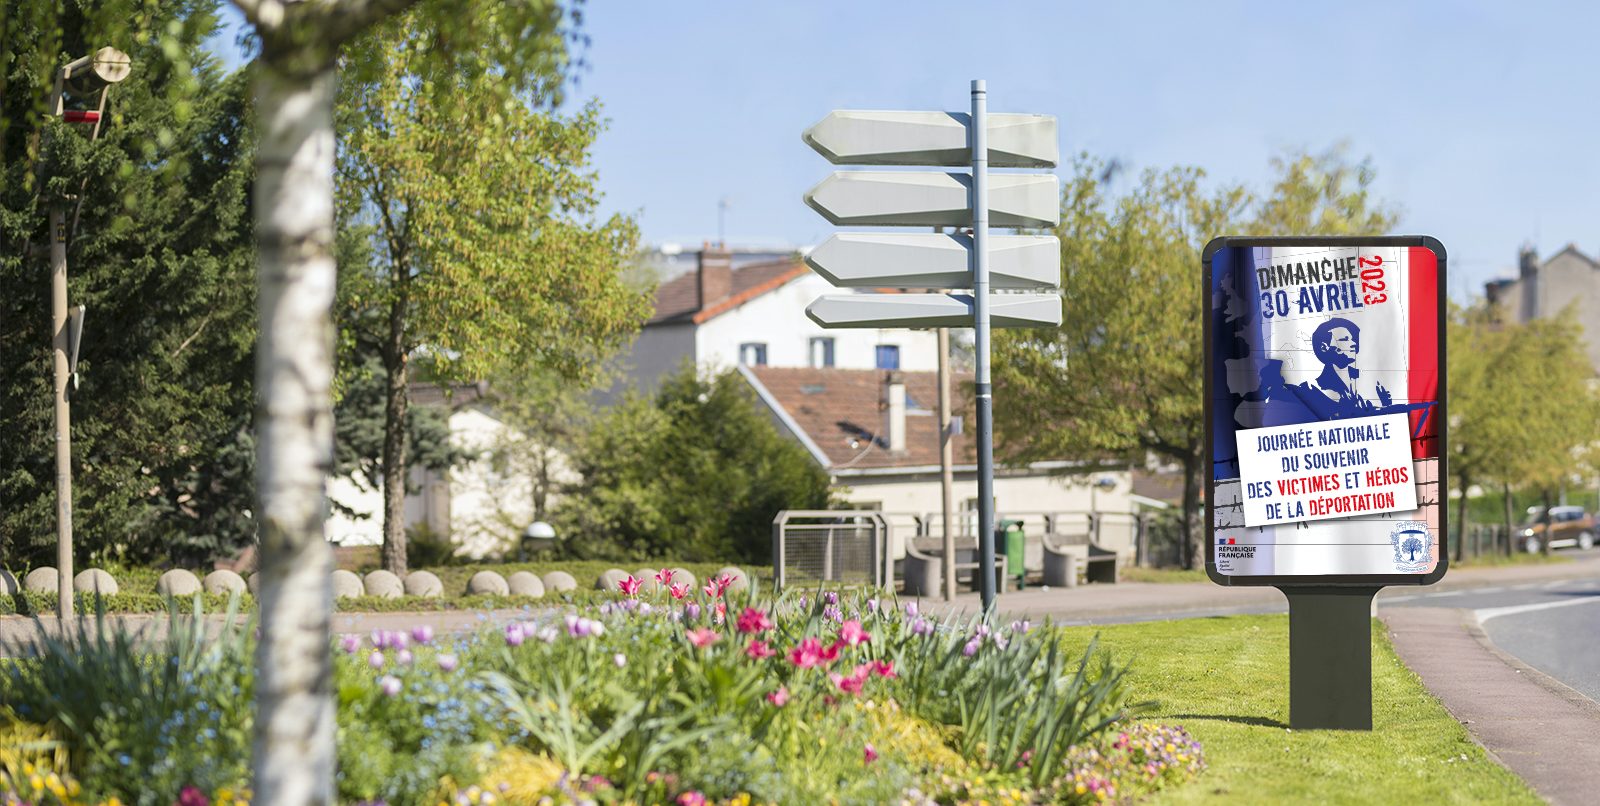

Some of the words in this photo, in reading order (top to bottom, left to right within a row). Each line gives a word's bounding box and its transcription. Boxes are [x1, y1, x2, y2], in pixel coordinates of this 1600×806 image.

[1256, 257, 1358, 290] DIMANCHE
[1359, 255, 1387, 305] 2023
[1261, 290, 1289, 319] 30
[1298, 281, 1363, 314] AVRIL
[1257, 429, 1314, 452] JOURNÉE
[1318, 423, 1390, 446] NATIONALE
[1282, 455, 1299, 473] DU
[1304, 448, 1369, 470] SOUVENIR
[1247, 480, 1273, 499] DES
[1277, 474, 1340, 496] VICTIMES
[1345, 472, 1360, 489] ET
[1366, 467, 1409, 487] HÉROS
[1266, 502, 1282, 520] DE
[1287, 501, 1304, 518] LA
[1309, 491, 1395, 516] DÉPORTATION
